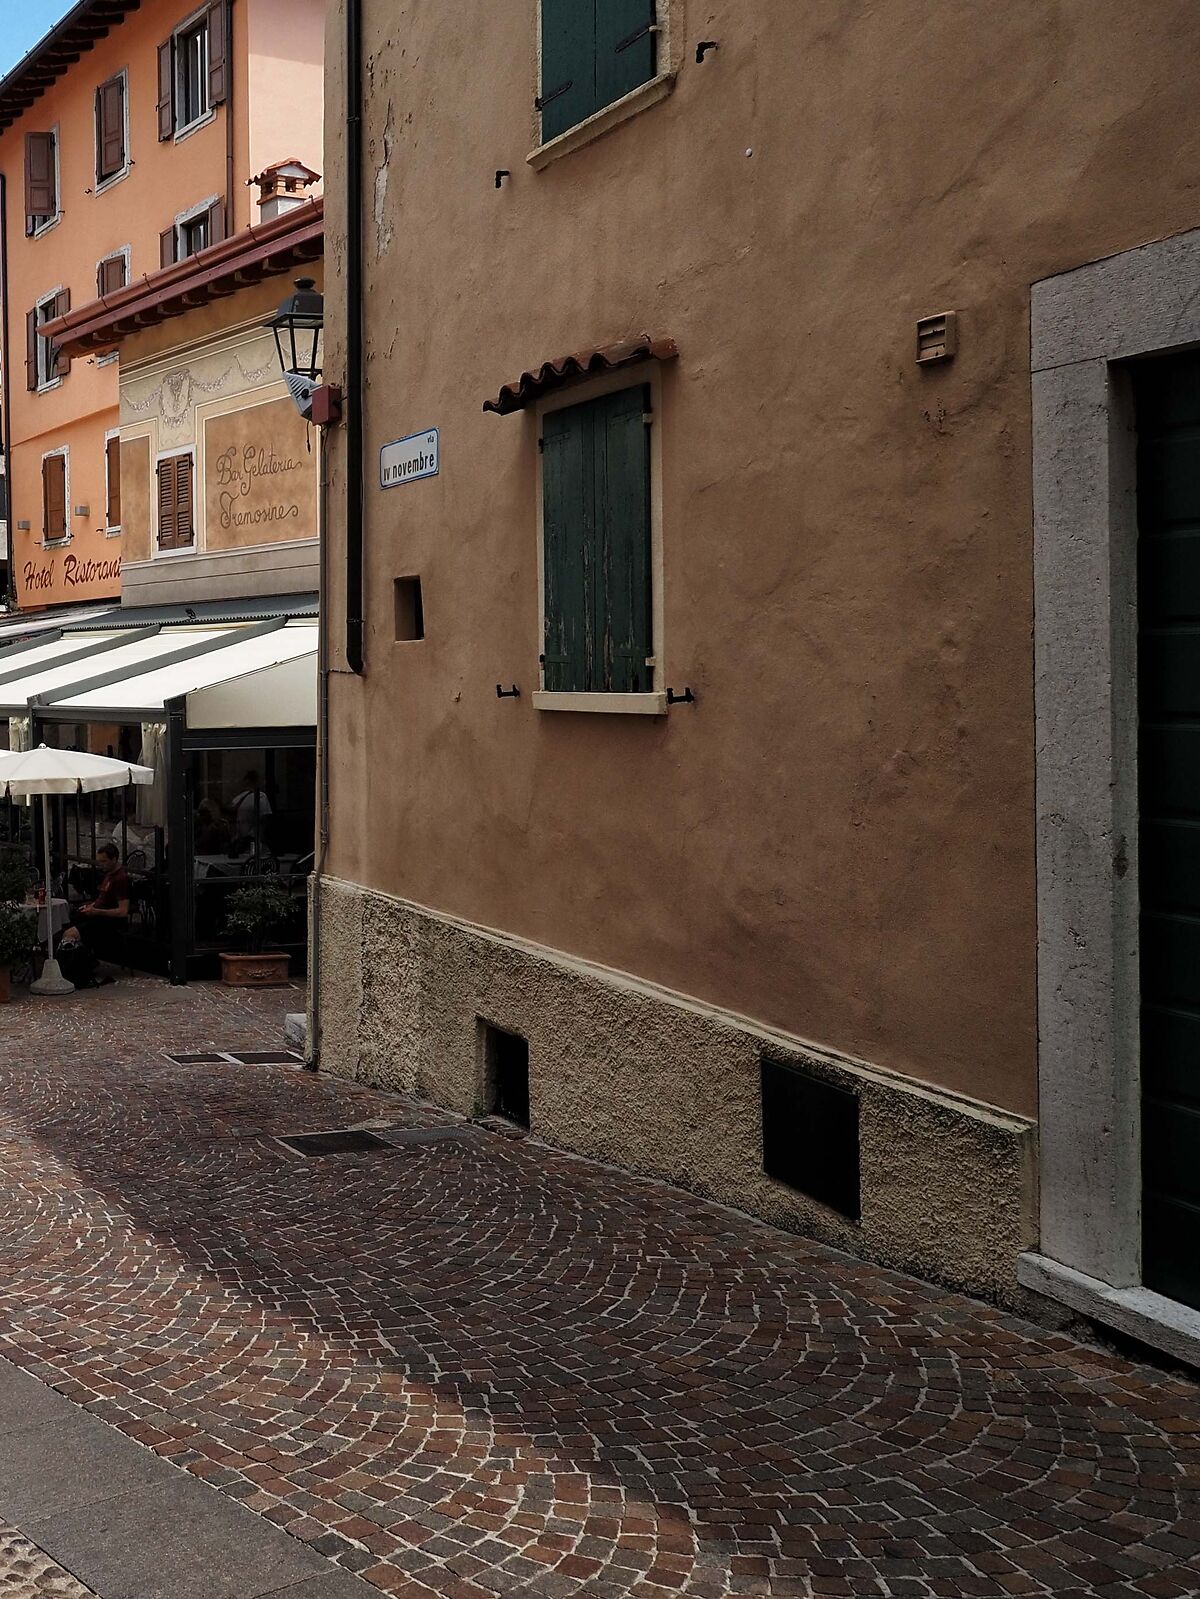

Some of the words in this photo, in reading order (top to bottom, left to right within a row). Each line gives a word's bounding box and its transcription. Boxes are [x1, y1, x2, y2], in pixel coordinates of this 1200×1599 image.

[216, 446, 243, 485] Bar
[240, 442, 302, 496] Gelateria
[392, 451, 435, 478] novembre
[220, 491, 299, 529] Tremosine
[23, 560, 54, 590] Hotel
